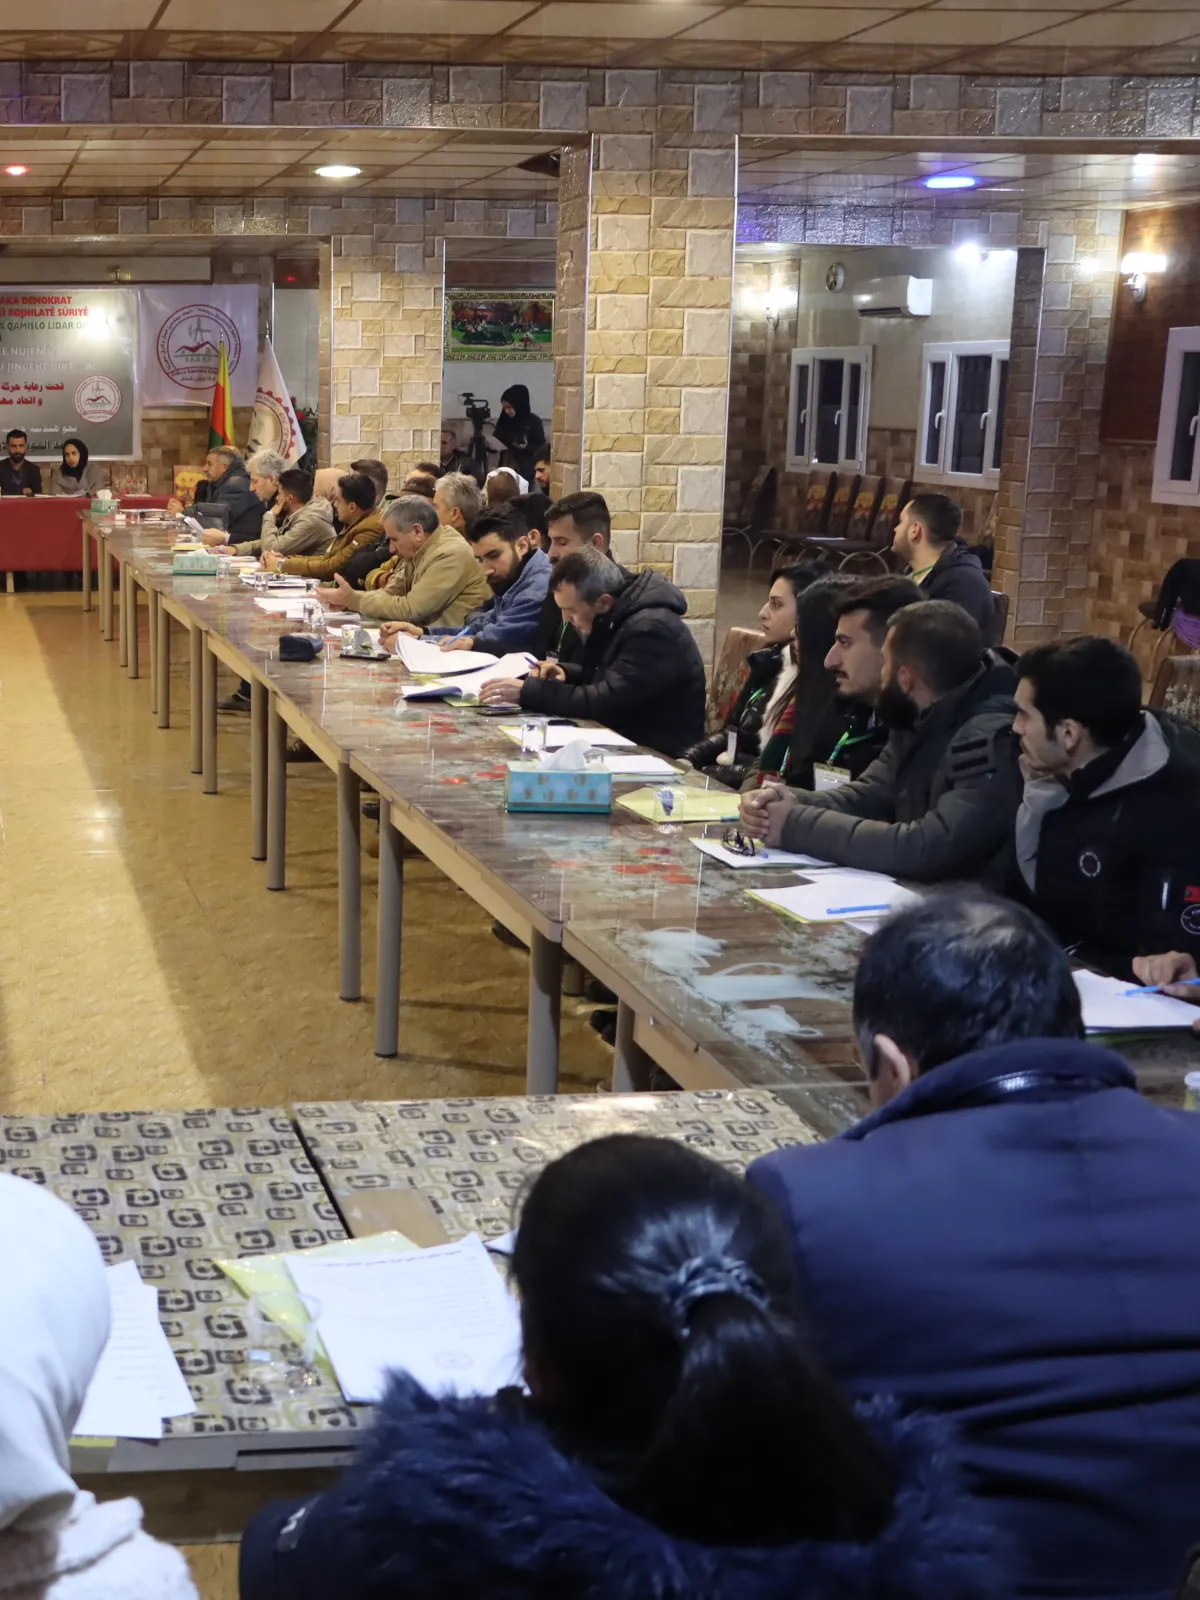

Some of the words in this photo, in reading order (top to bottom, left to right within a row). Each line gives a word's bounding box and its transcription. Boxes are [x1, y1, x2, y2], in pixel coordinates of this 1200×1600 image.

[22, 296, 72, 305] DEMOKRAT
[0, 306, 6, 317] Û
[58, 306, 88, 316] SÛRIYÊ
[48, 321, 74, 330] LIDAR
[0, 382, 21, 393] حركة
[24, 382, 44, 393] رعاية
[46, 382, 65, 392] تحت
